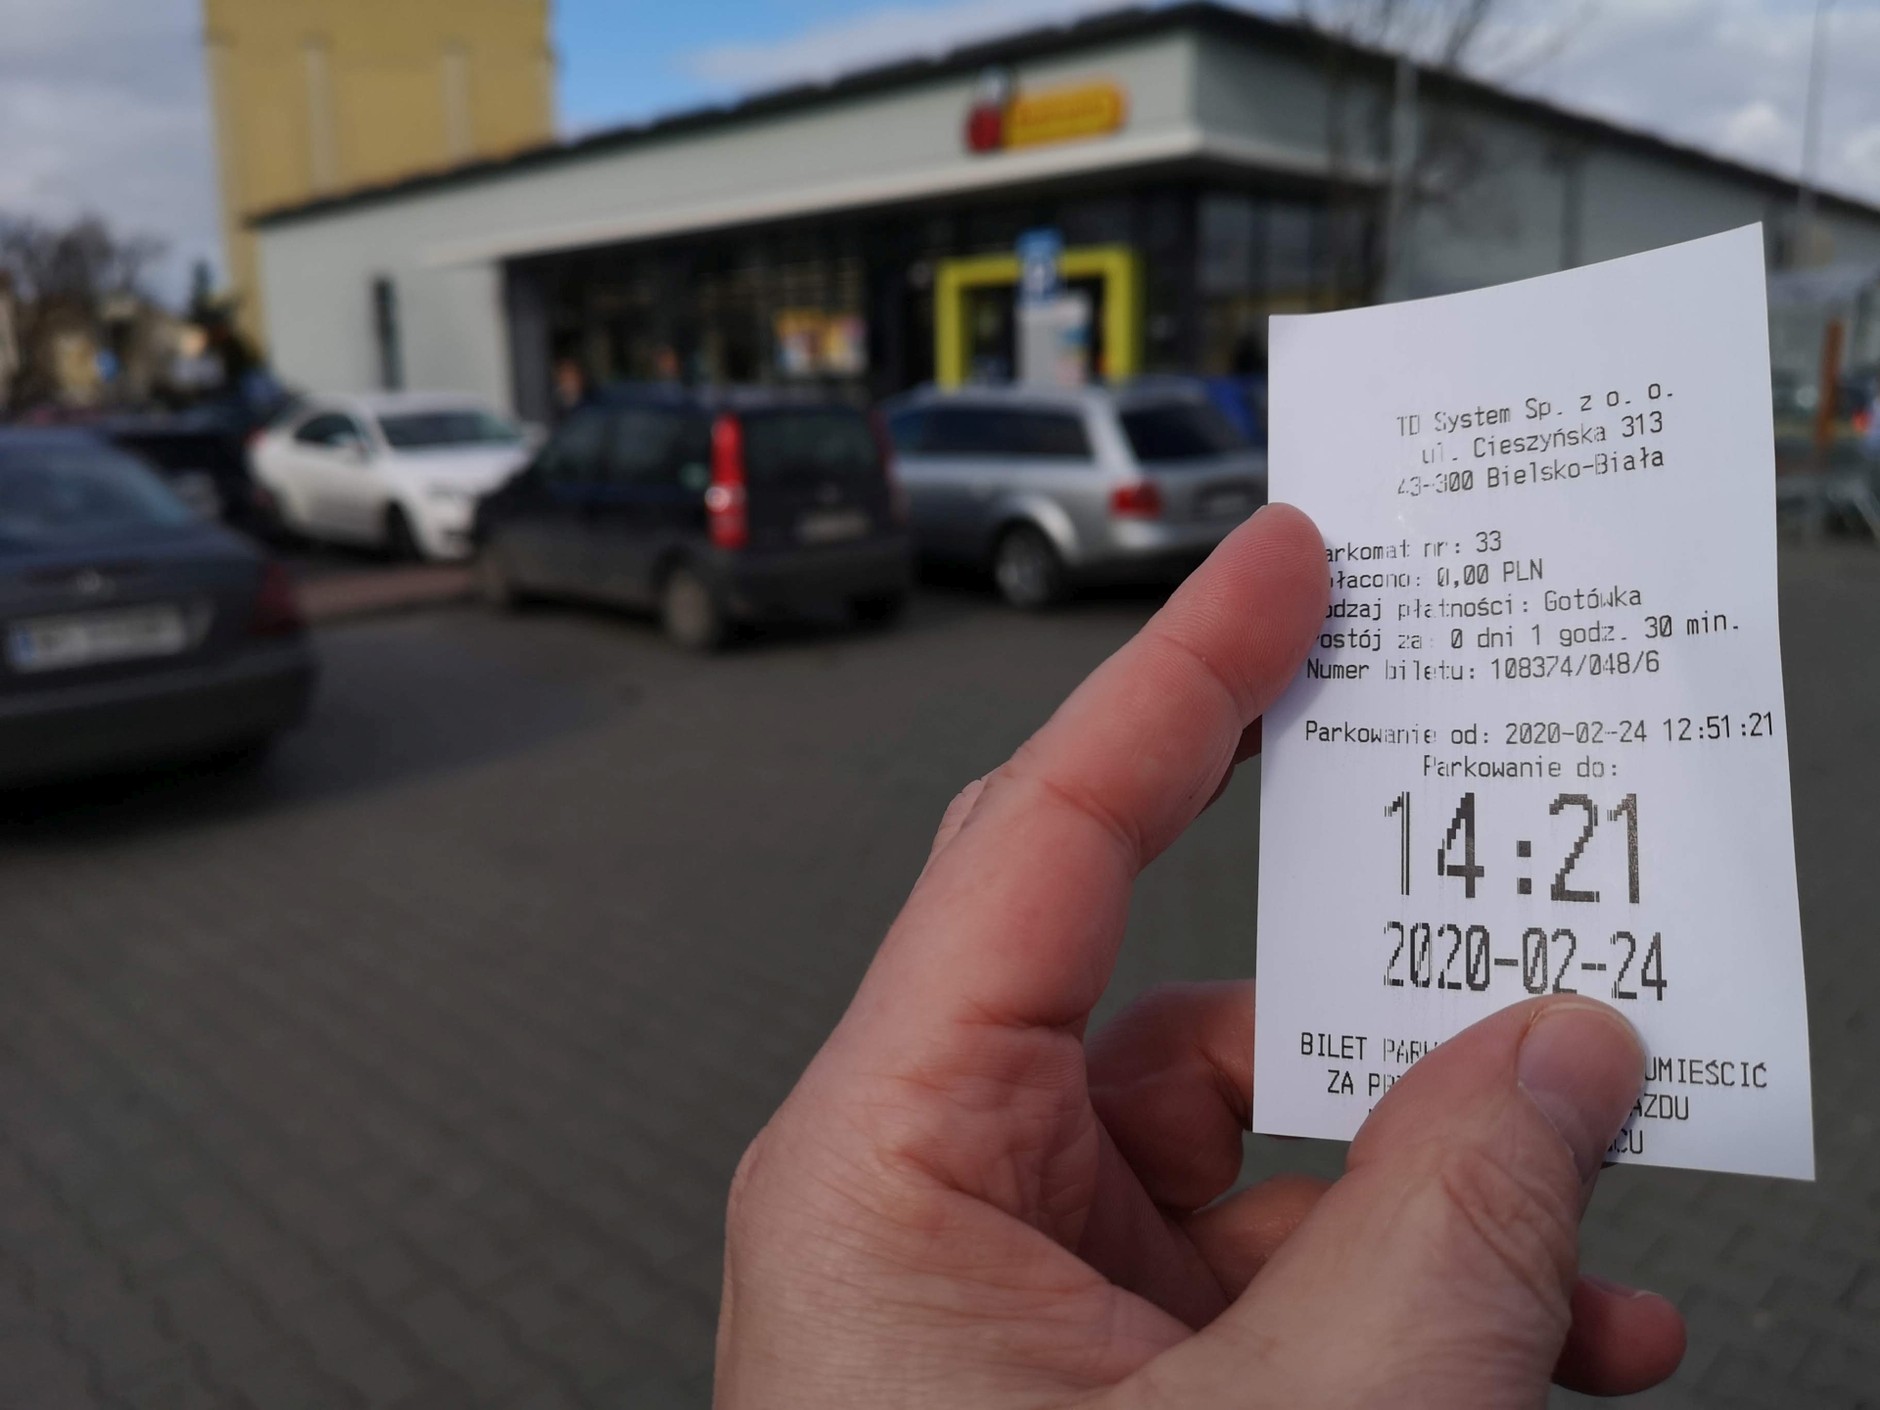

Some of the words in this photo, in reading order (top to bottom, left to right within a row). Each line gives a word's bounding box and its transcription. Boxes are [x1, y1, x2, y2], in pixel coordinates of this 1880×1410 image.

[1396, 413, 1421, 437] TD
[1434, 405, 1511, 433] System
[1525, 397, 1563, 421] Sp.
[1579, 394, 1592, 412] z
[1606, 390, 1631, 408] o.
[1647, 382, 1673, 401] o.
[1473, 423, 1606, 459] Cieszyńska
[1621, 410, 1663, 438] 313
[1397, 469, 1474, 497] 43-300
[1487, 446, 1664, 489] Bielsko-Biała
[1326, 538, 1410, 562] arkomat
[1423, 539, 1461, 558] nr:
[1475, 529, 1502, 552] 33
[1330, 569, 1421, 589] łacono:
[1437, 563, 1489, 589] 0,00
[1503, 558, 1544, 583] PLN
[1325, 597, 1382, 621] dzaj
[1398, 592, 1529, 621] płatności:
[1544, 585, 1642, 613] Gotówka
[1316, 627, 1382, 652] ostój
[1450, 627, 1463, 650] 0
[1477, 624, 1514, 648] dni
[1531, 623, 1541, 646] 1
[1559, 620, 1628, 647] godz.
[1644, 614, 1673, 639] 30
[1686, 610, 1740, 636] min.
[1306, 657, 1370, 680] Numer
[1384, 658, 1476, 681] biletu:
[1490, 650, 1661, 681] 108374/048/6
[1305, 720, 1438, 746] Parkowanie
[1450, 724, 1492, 745] od:
[1505, 720, 1649, 745] 2020-02-24
[1423, 754, 1563, 779] Parkowanie
[1576, 754, 1620, 779] do:
[1384, 790, 1641, 905] 14:21
[1383, 920, 1668, 1002] 2020-02-24
[1300, 1031, 1368, 1061] BILET
[1327, 1069, 1354, 1096] ZA
